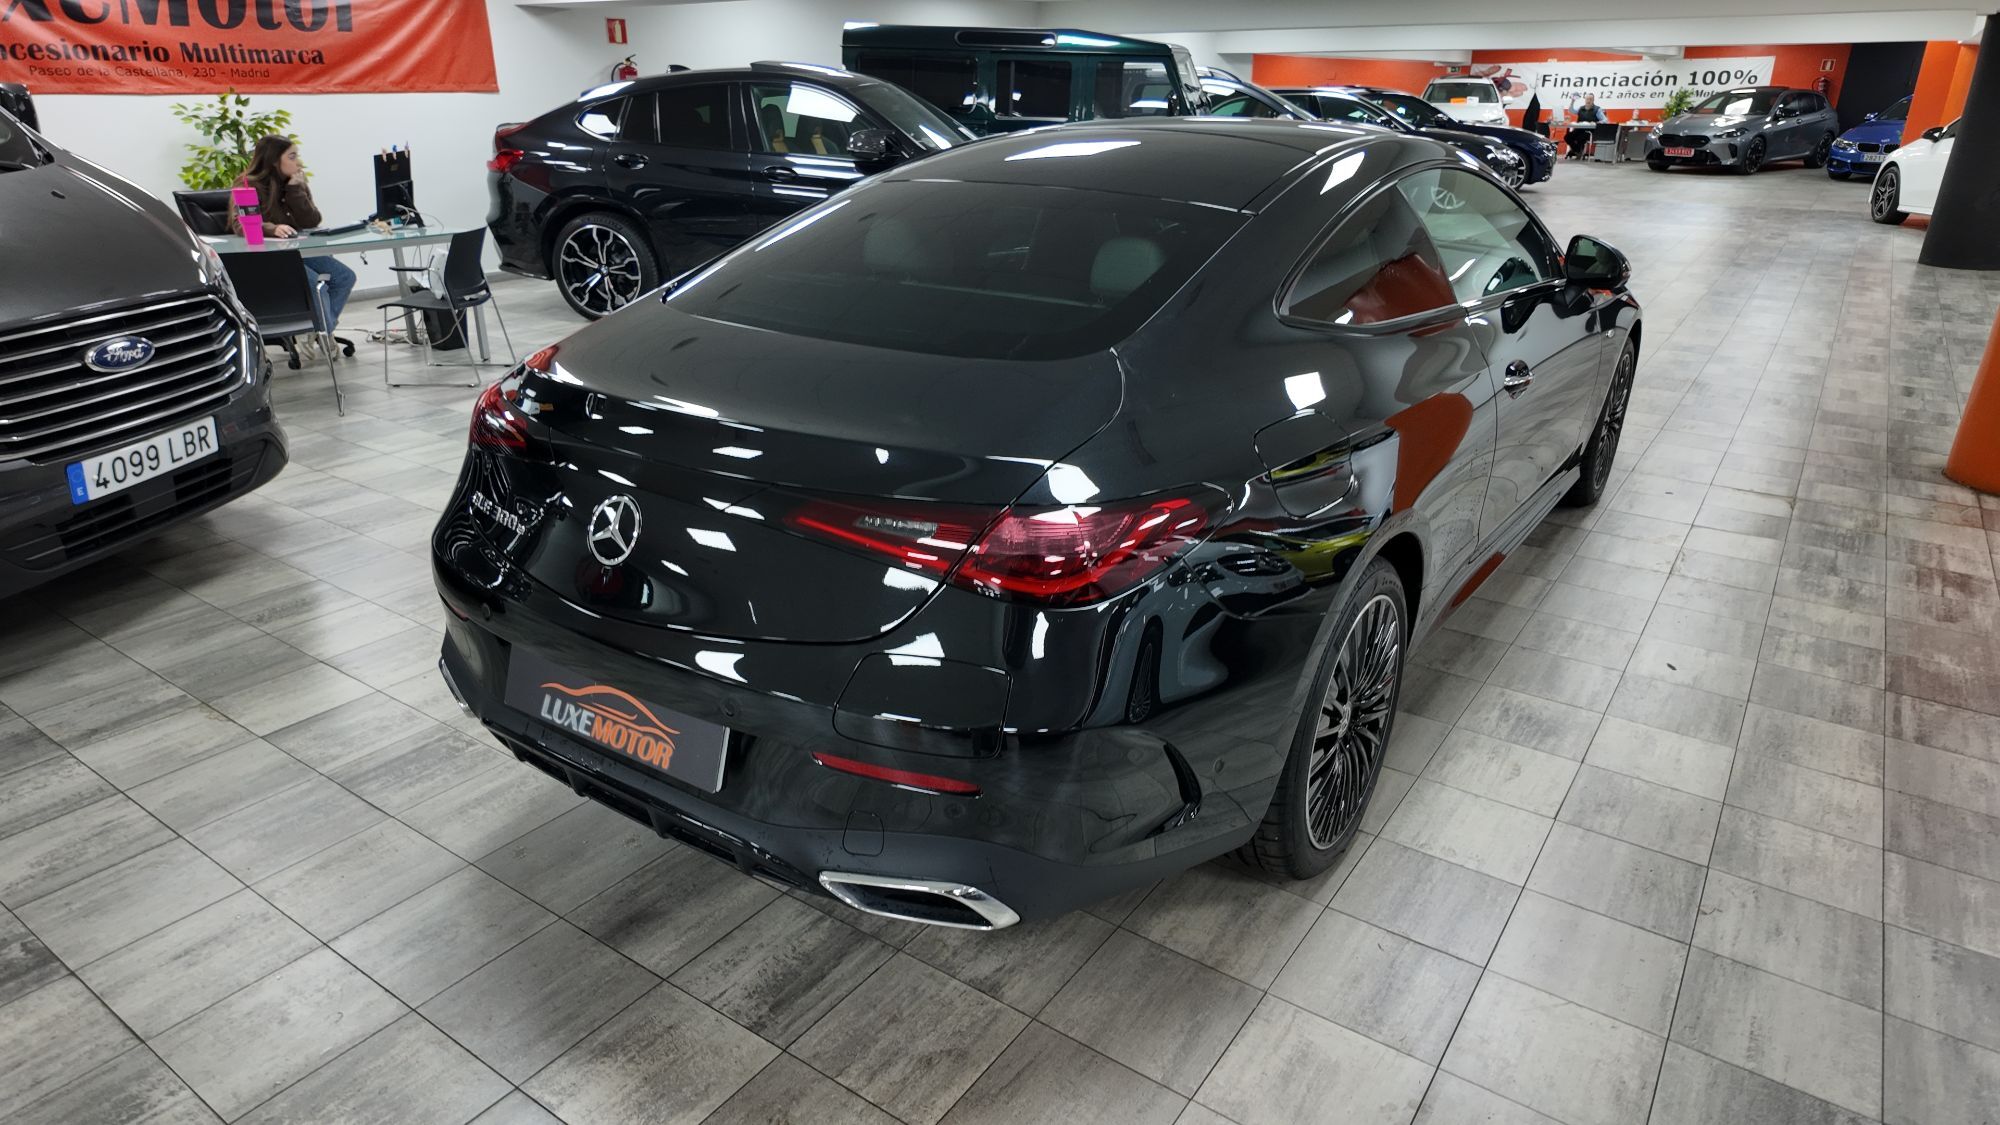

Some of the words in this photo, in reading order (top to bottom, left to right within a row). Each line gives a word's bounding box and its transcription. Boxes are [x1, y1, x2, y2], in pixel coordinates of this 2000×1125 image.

[179, 42, 325, 65] Multimarca
[29, 65, 71, 77] Paseo
[77, 65, 94, 76] de
[115, 65, 188, 79] Castellana,
[192, 67, 216, 78] 230
[231, 68, 270, 78] Madrid
[1541, 70, 1678, 88] Financiación
[1687, 69, 1758, 86] 100%
[1560, 91, 1595, 99] Hst
[1599, 91, 1613, 99] 12
[1616, 90, 1646, 99] años
[1649, 91, 1665, 99] en
[103, 343, 145, 363] Ford
[76, 487, 84, 496] E
[95, 444, 160, 489] 4099
[168, 425, 212, 463] LBR
[540, 693, 674, 770] LUXEMOTOR
